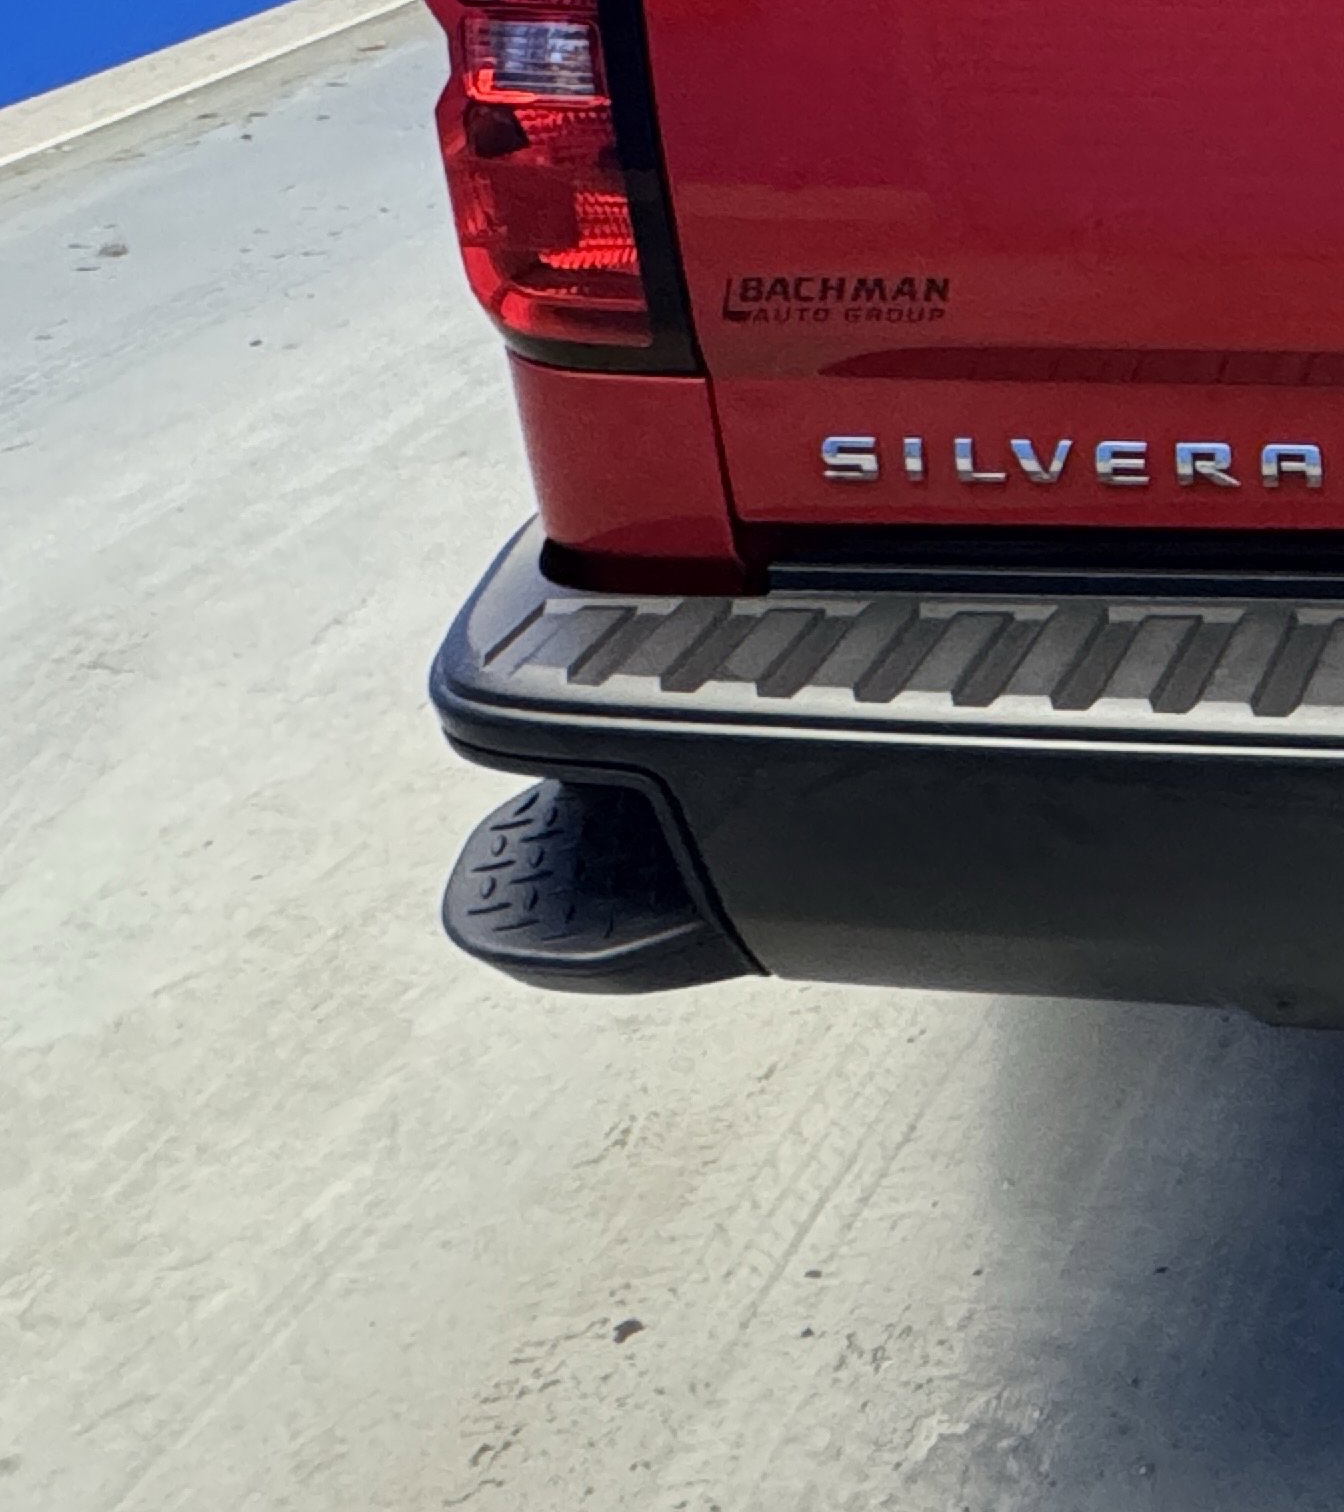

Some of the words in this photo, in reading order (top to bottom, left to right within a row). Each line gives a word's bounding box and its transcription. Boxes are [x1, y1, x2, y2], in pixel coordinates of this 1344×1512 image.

[741, 277, 949, 302] BACHMAN
[752, 307, 829, 324] AUTO
[844, 307, 945, 324] GROUP
